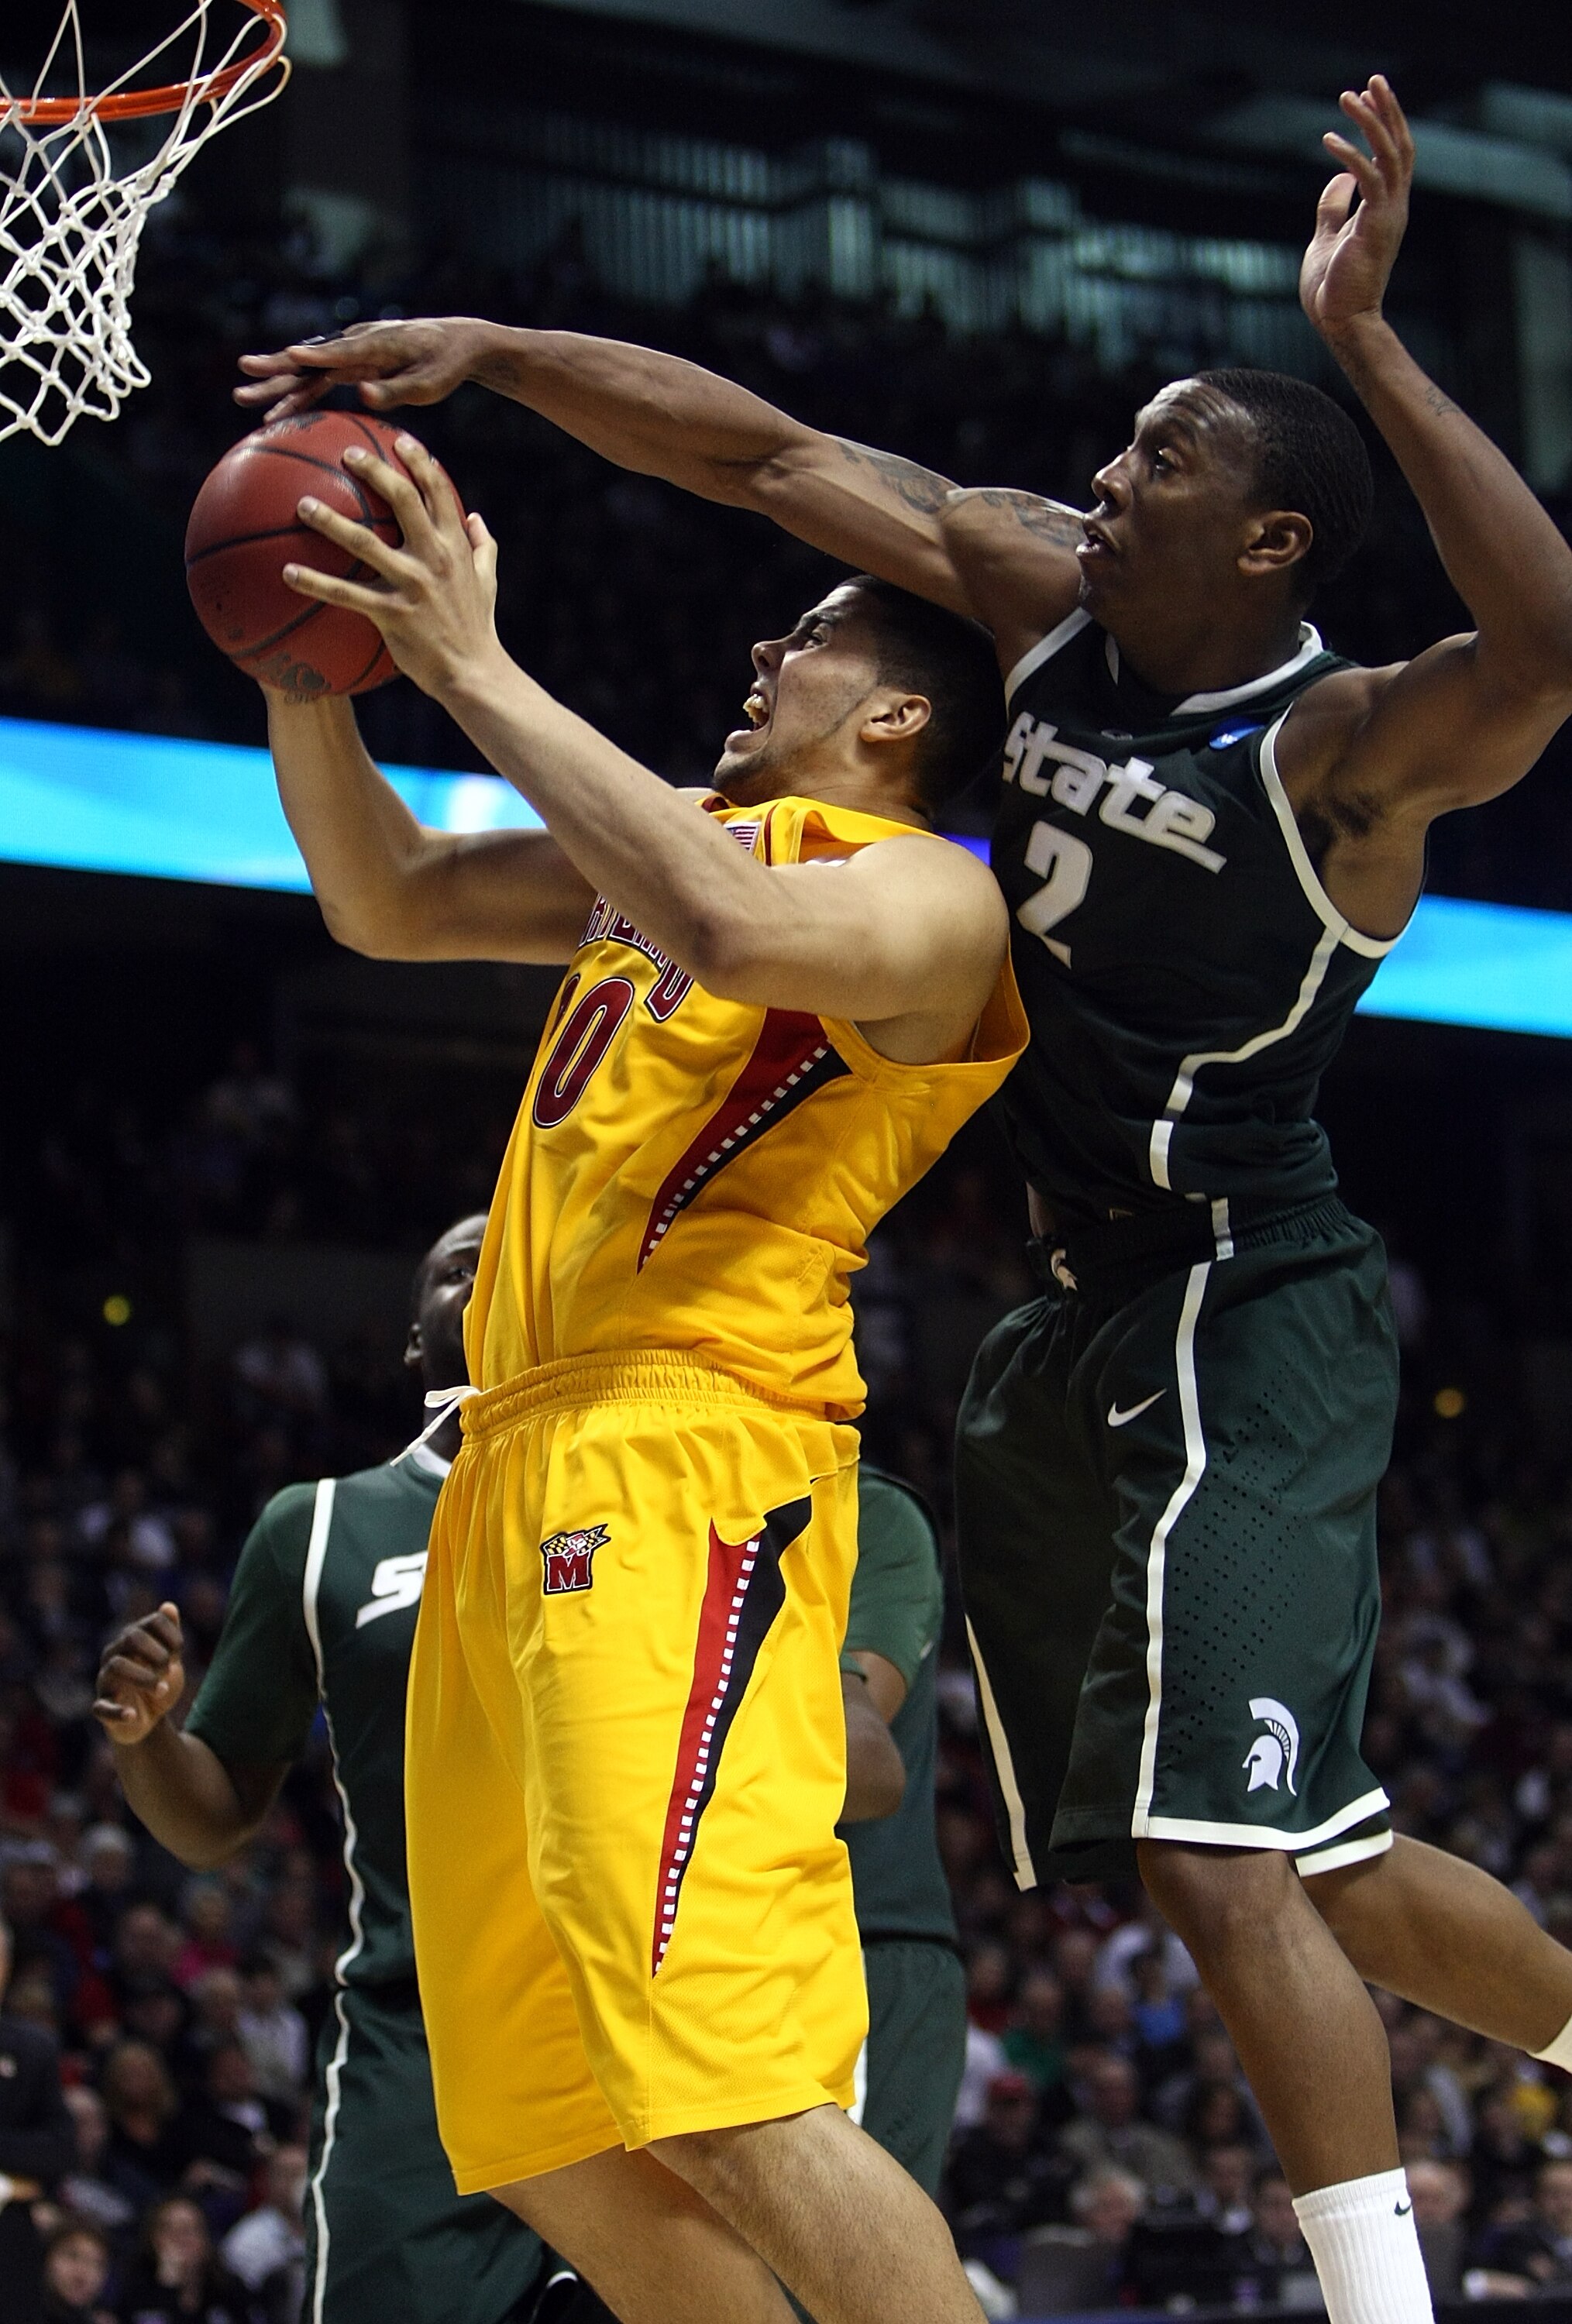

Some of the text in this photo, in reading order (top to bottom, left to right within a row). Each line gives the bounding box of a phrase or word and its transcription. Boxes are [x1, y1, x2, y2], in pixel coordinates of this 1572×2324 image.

[1002, 710, 1228, 875] State
[1015, 820, 1094, 970] 2
[545, 1548, 593, 1594] M
